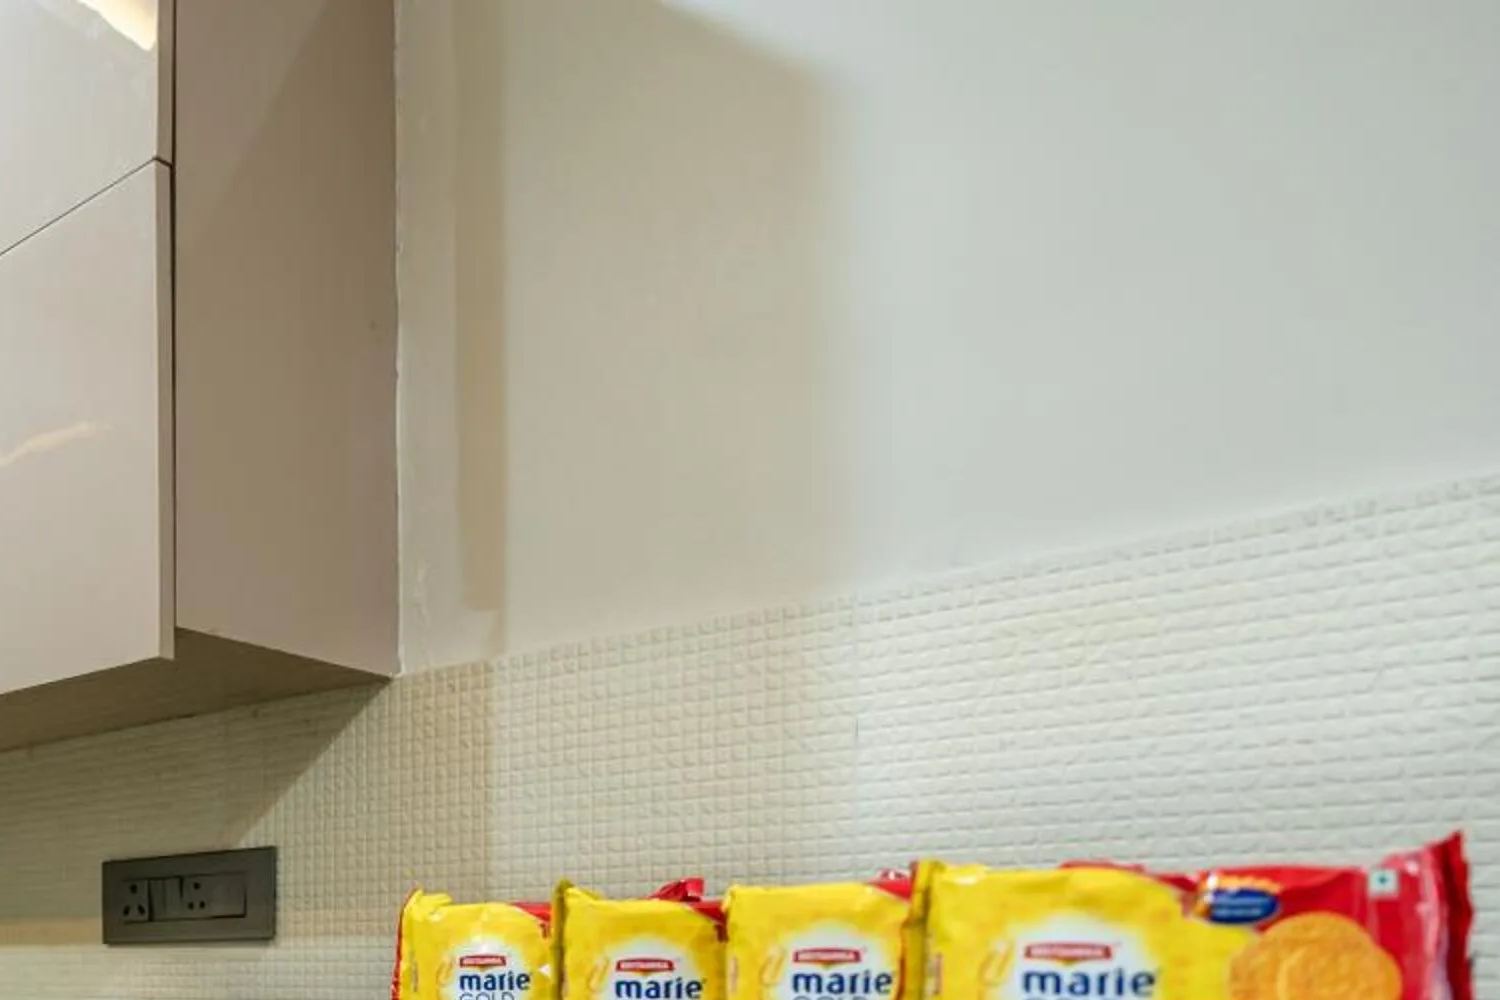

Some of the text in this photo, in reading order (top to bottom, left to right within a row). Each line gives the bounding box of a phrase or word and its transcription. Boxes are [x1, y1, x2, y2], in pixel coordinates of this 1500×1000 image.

[459, 970, 531, 991] marie
[614, 976, 703, 1000] marie
[791, 968, 893, 995] marie
[1022, 966, 1156, 998] marie
